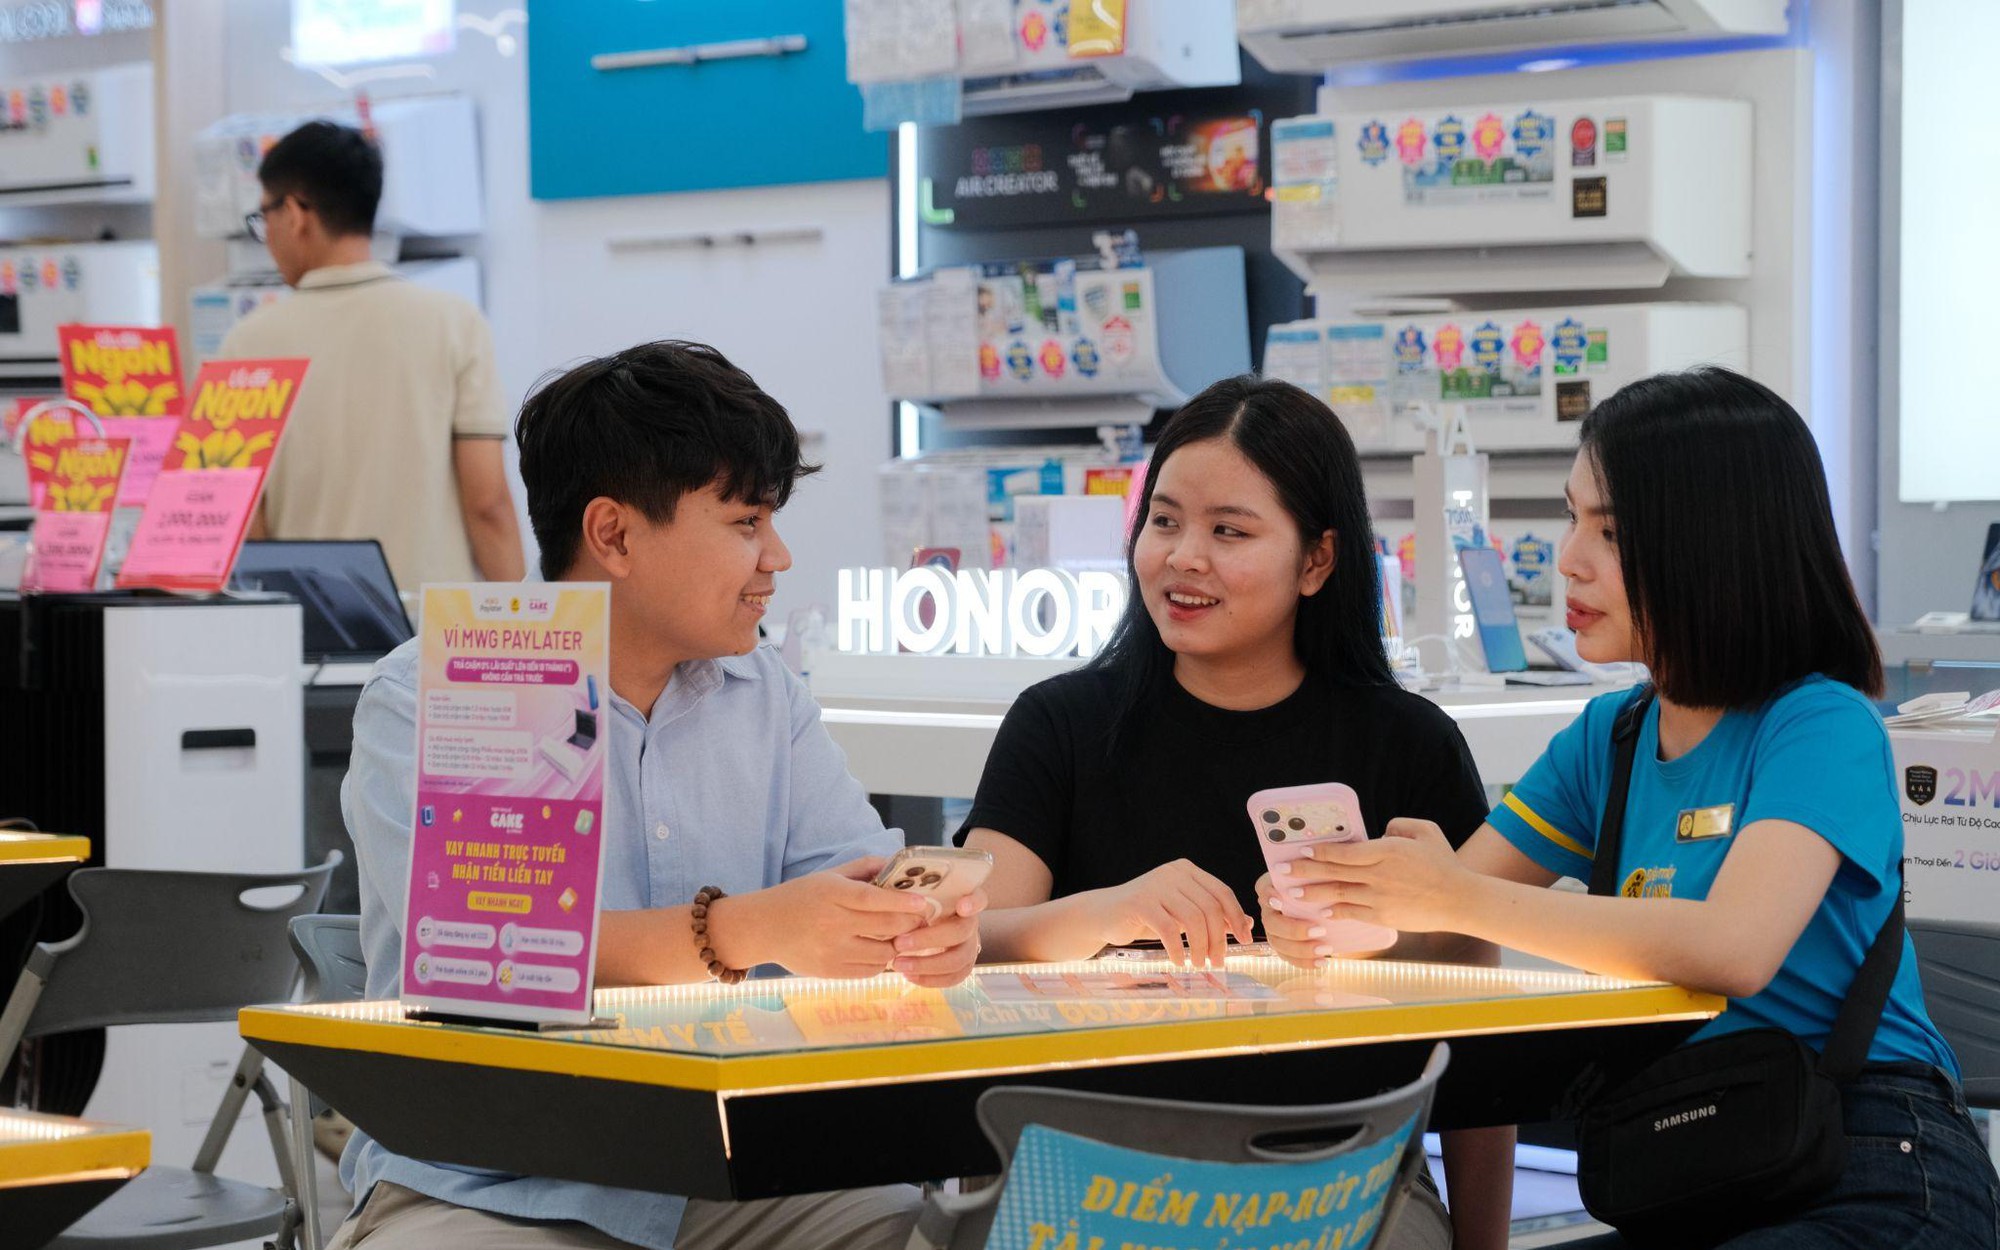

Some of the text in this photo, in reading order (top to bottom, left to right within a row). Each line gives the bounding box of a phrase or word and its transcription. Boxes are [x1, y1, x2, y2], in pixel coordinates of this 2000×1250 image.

[838, 565, 1125, 657] HONOR
[444, 624, 582, 651] VÍ MWG PAYLATER
[1944, 767, 2000, 809] 2M
[490, 813, 524, 829] CAKE
[1902, 813, 1922, 825] Chịu
[1924, 813, 1939, 826] Lực
[1941, 815, 1955, 826] Rơi
[1956, 816, 1967, 827] Từ
[1969, 817, 1982, 829] Độ
[446, 841, 566, 864] VAY NHANH TRỰC TUYẾN
[1914, 857, 1935, 867] Thoại
[1936, 859, 1952, 868] Đến
[1954, 849, 1964, 868] 2
[452, 862, 554, 885] NHẬN TIỀN LIỀN TAY
[487, 897, 507, 908] NHANH
[1654, 1104, 1717, 1132] SAMSUNG
[1081, 1173, 1200, 1227] ĐIỂM
[1204, 1170, 1360, 1236] NẠP-RÚT
